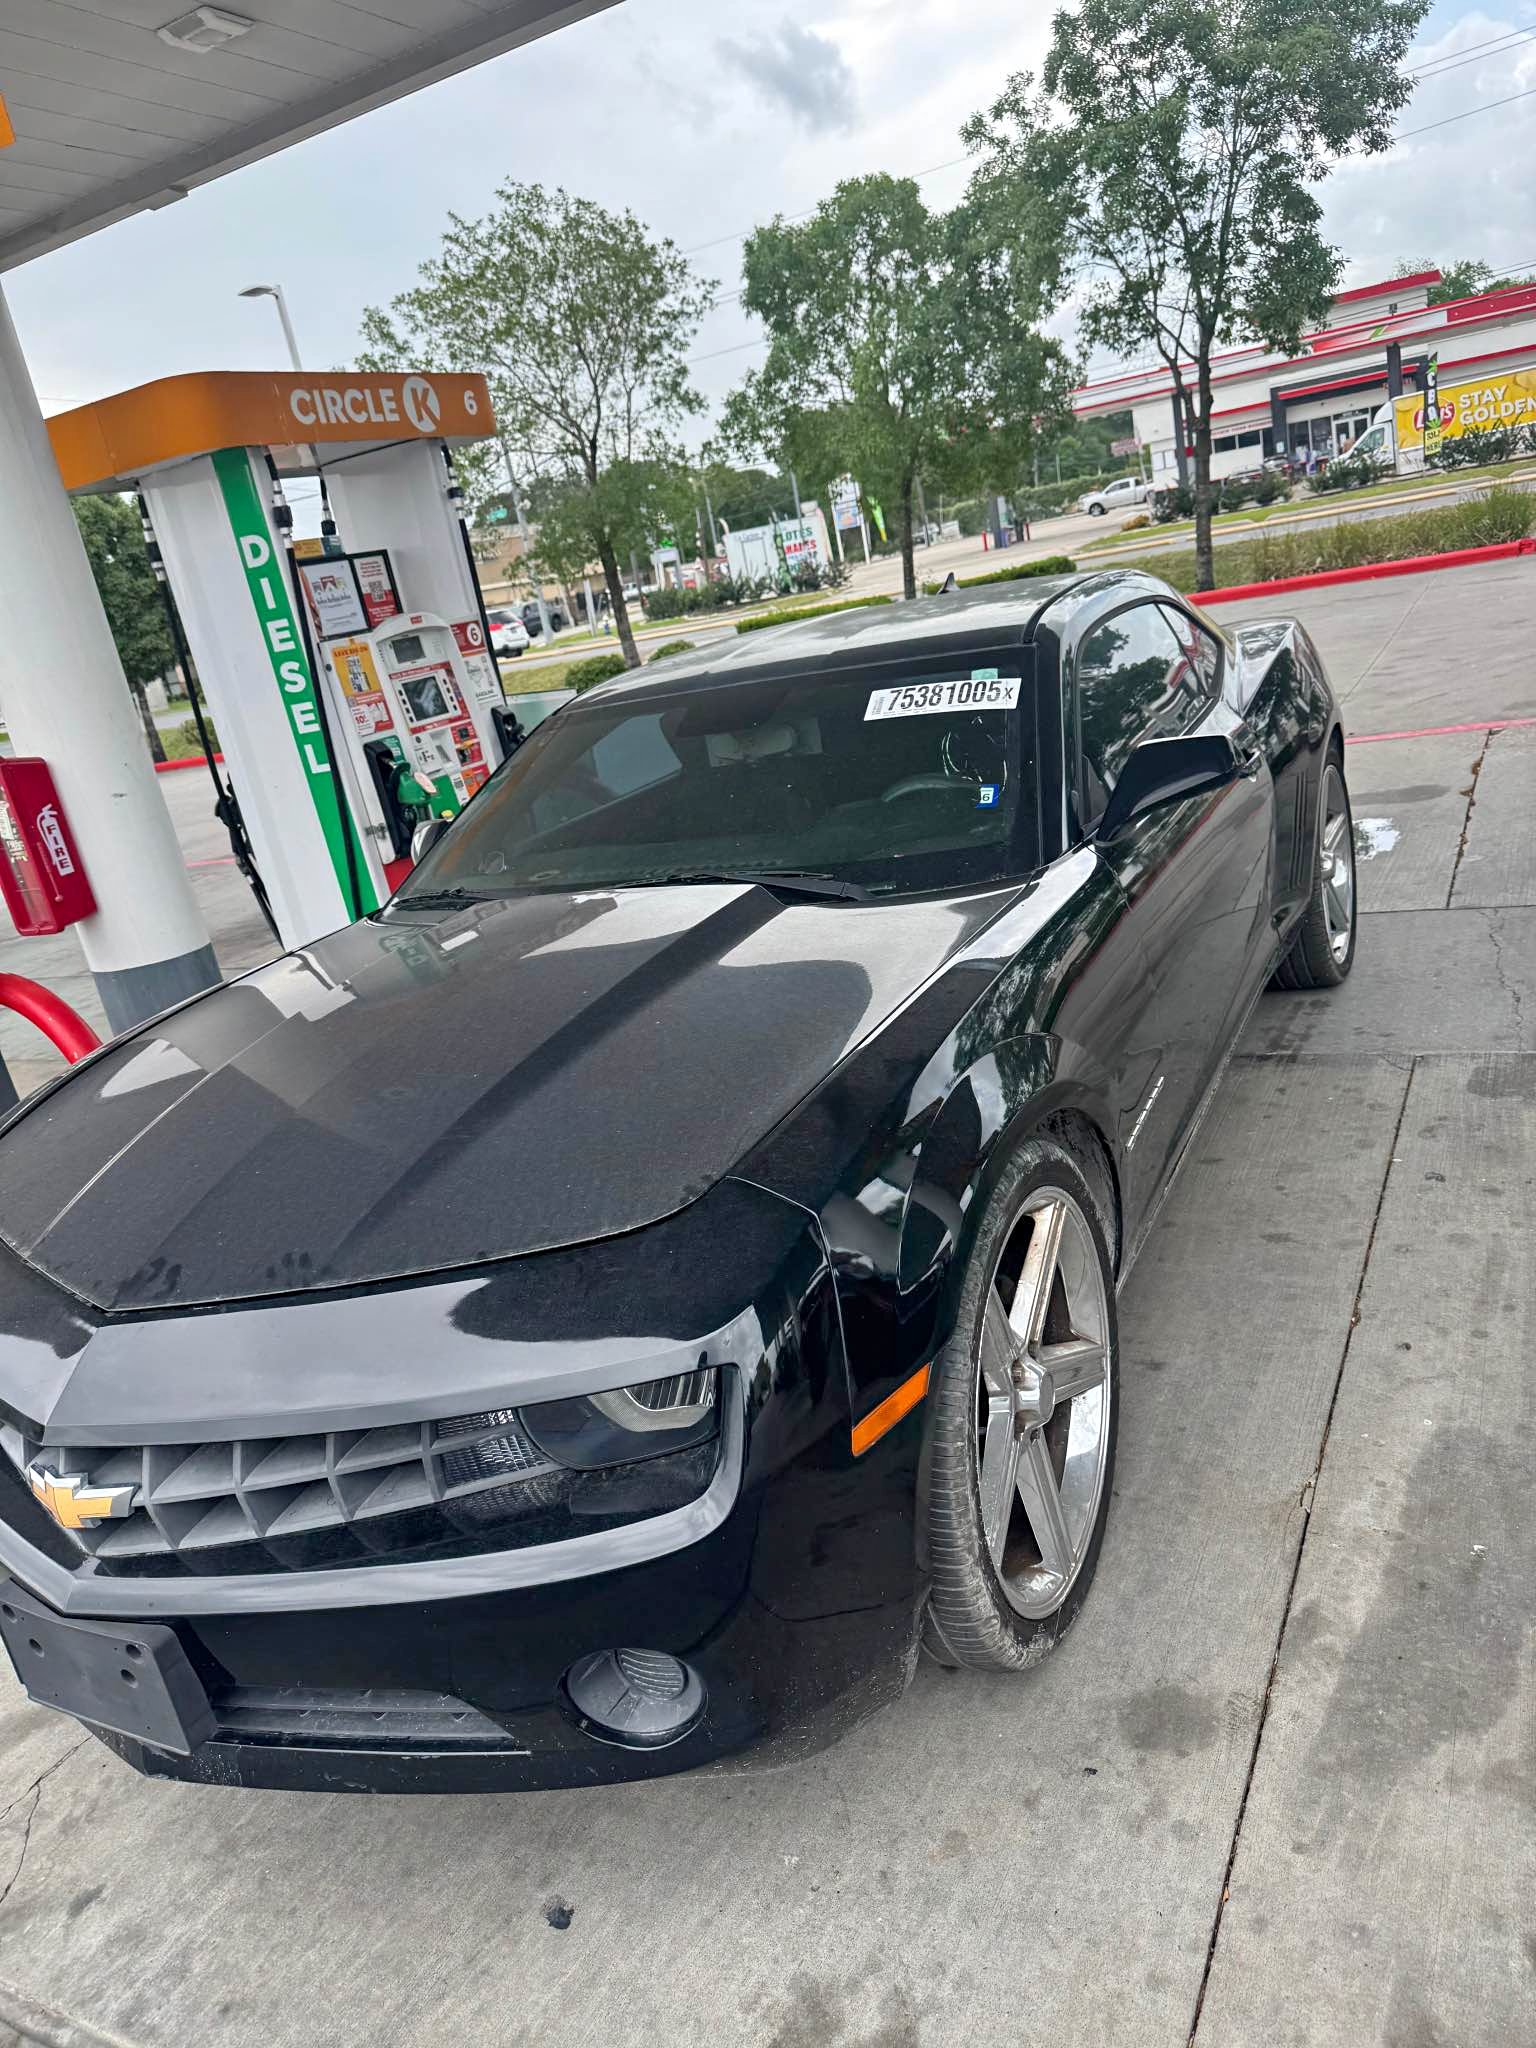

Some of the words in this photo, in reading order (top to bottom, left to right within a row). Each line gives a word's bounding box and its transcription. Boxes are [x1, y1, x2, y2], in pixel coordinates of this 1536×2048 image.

[290, 388, 400, 424] CIRCLE
[406, 381, 441, 431] K
[464, 390, 478, 416] 6
[1459, 384, 1507, 408] STAY
[470, 627, 479, 642] 6
[240, 535, 331, 774] DIESEL
[982, 793, 990, 802] 6
[46, 824, 70, 869] FIRE
